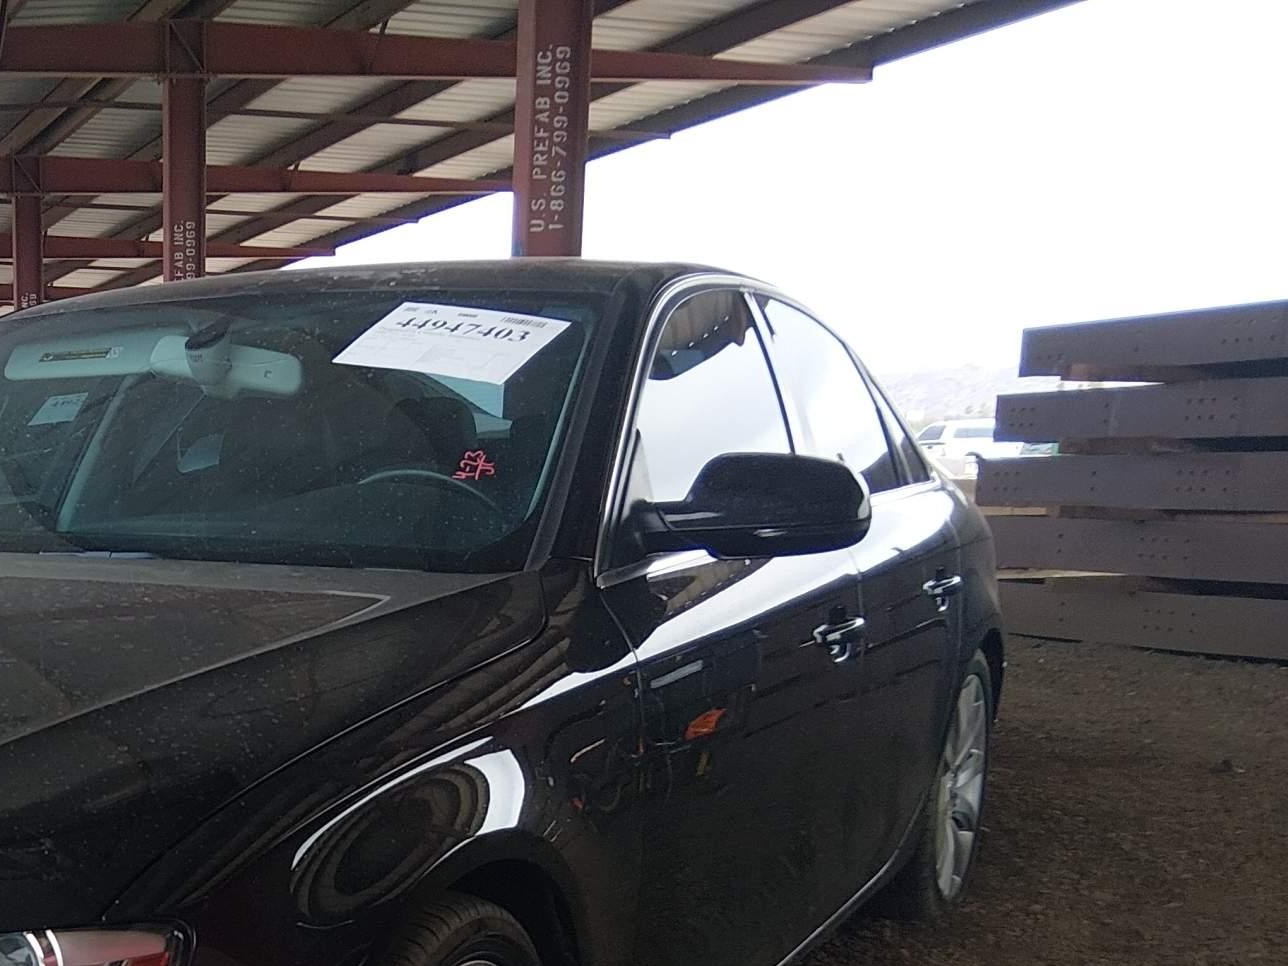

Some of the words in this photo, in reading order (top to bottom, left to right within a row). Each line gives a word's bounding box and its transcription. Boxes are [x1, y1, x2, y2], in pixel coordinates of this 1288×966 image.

[536, 44, 554, 85] INC.
[532, 96, 551, 180] PREFAB
[548, 45, 572, 231] 1-866-799-0969
[173, 219, 185, 245] INC.
[529, 193, 547, 232] U.S.
[174, 251, 185, 281] FAB
[396, 316, 532, 343] 44947403
